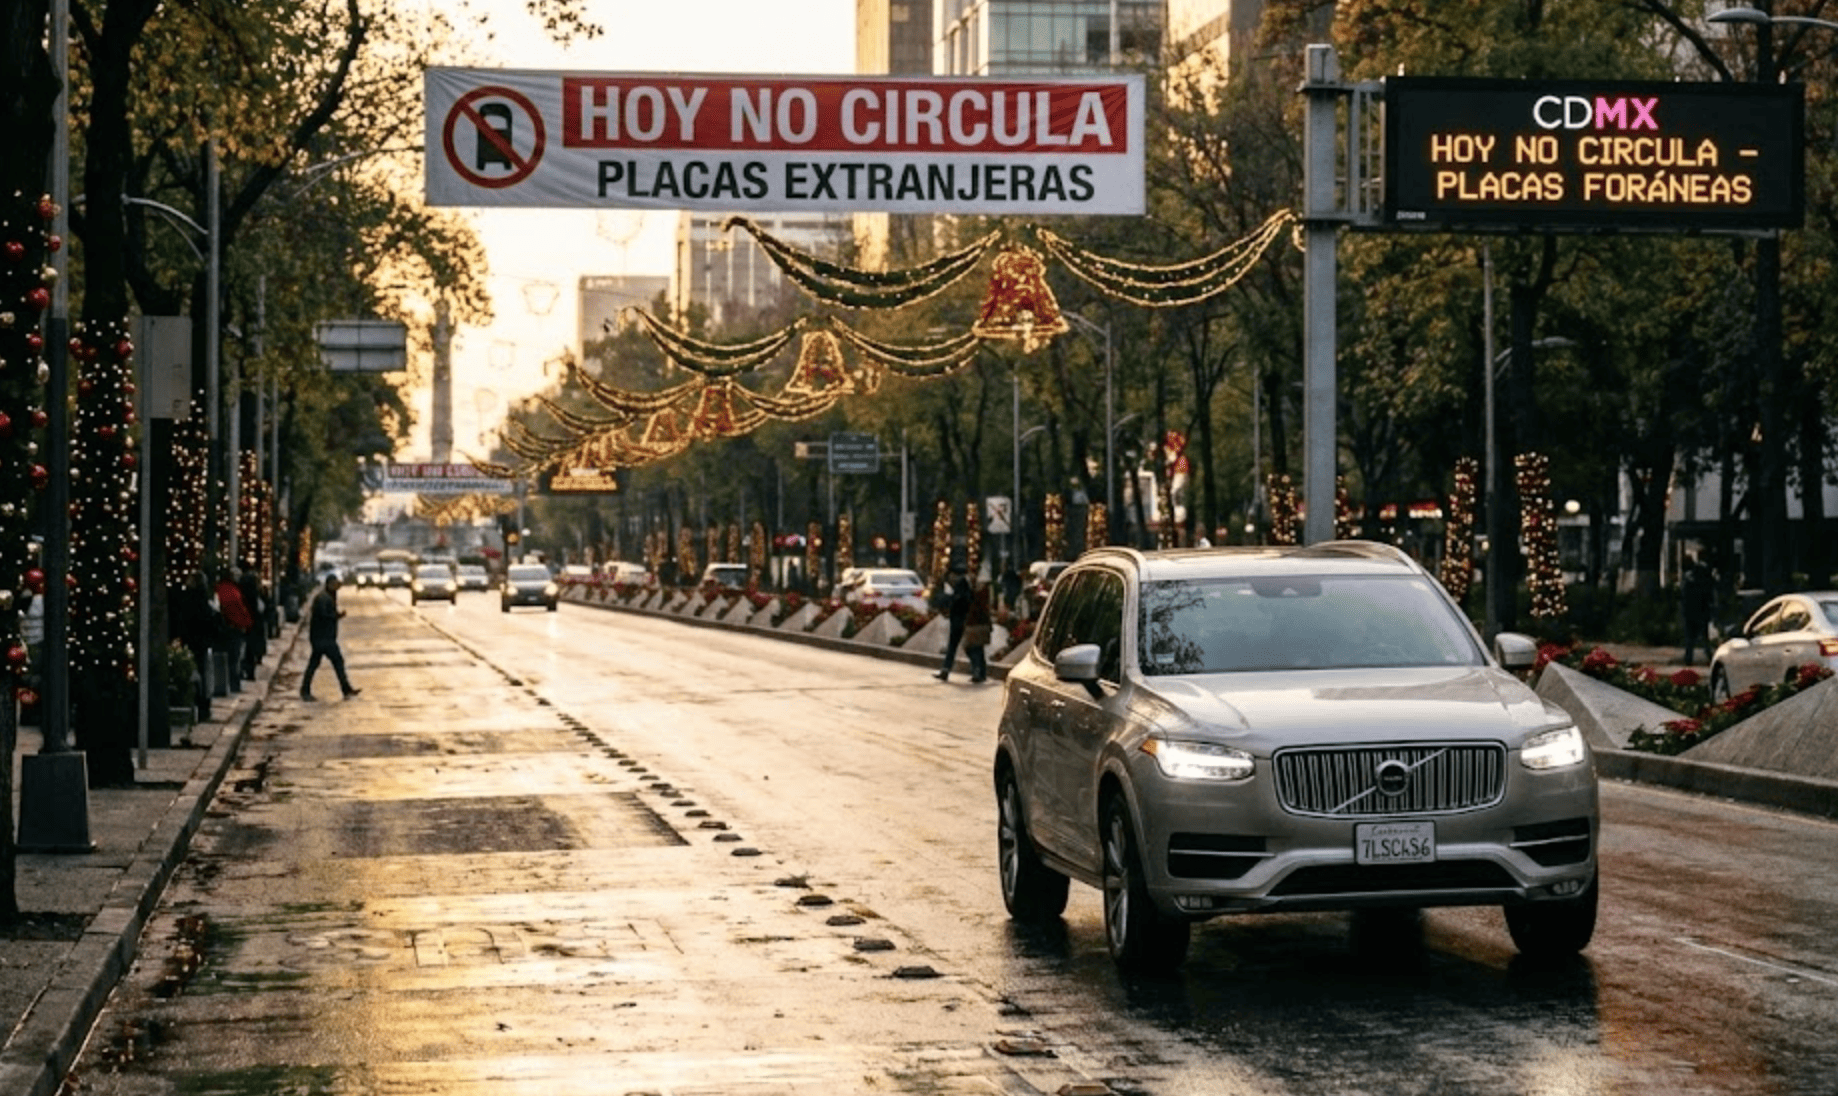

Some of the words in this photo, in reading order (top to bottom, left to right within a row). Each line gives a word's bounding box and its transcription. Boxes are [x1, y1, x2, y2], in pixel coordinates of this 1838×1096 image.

[581, 85, 708, 141] HOY
[731, 87, 817, 143] NO
[841, 88, 1113, 147] CIRCULA
[1532, 95, 1659, 130] CDMX
[1430, 134, 1495, 163] HOY
[1515, 135, 1558, 164] NO
[1578, 136, 1718, 167] CIRCULA
[597, 159, 769, 200] PLACAS
[785, 161, 1095, 202] EXTRANJERAS
[1436, 171, 1564, 201] PLACAS
[1584, 169, 1752, 203] FORÁNEAS
